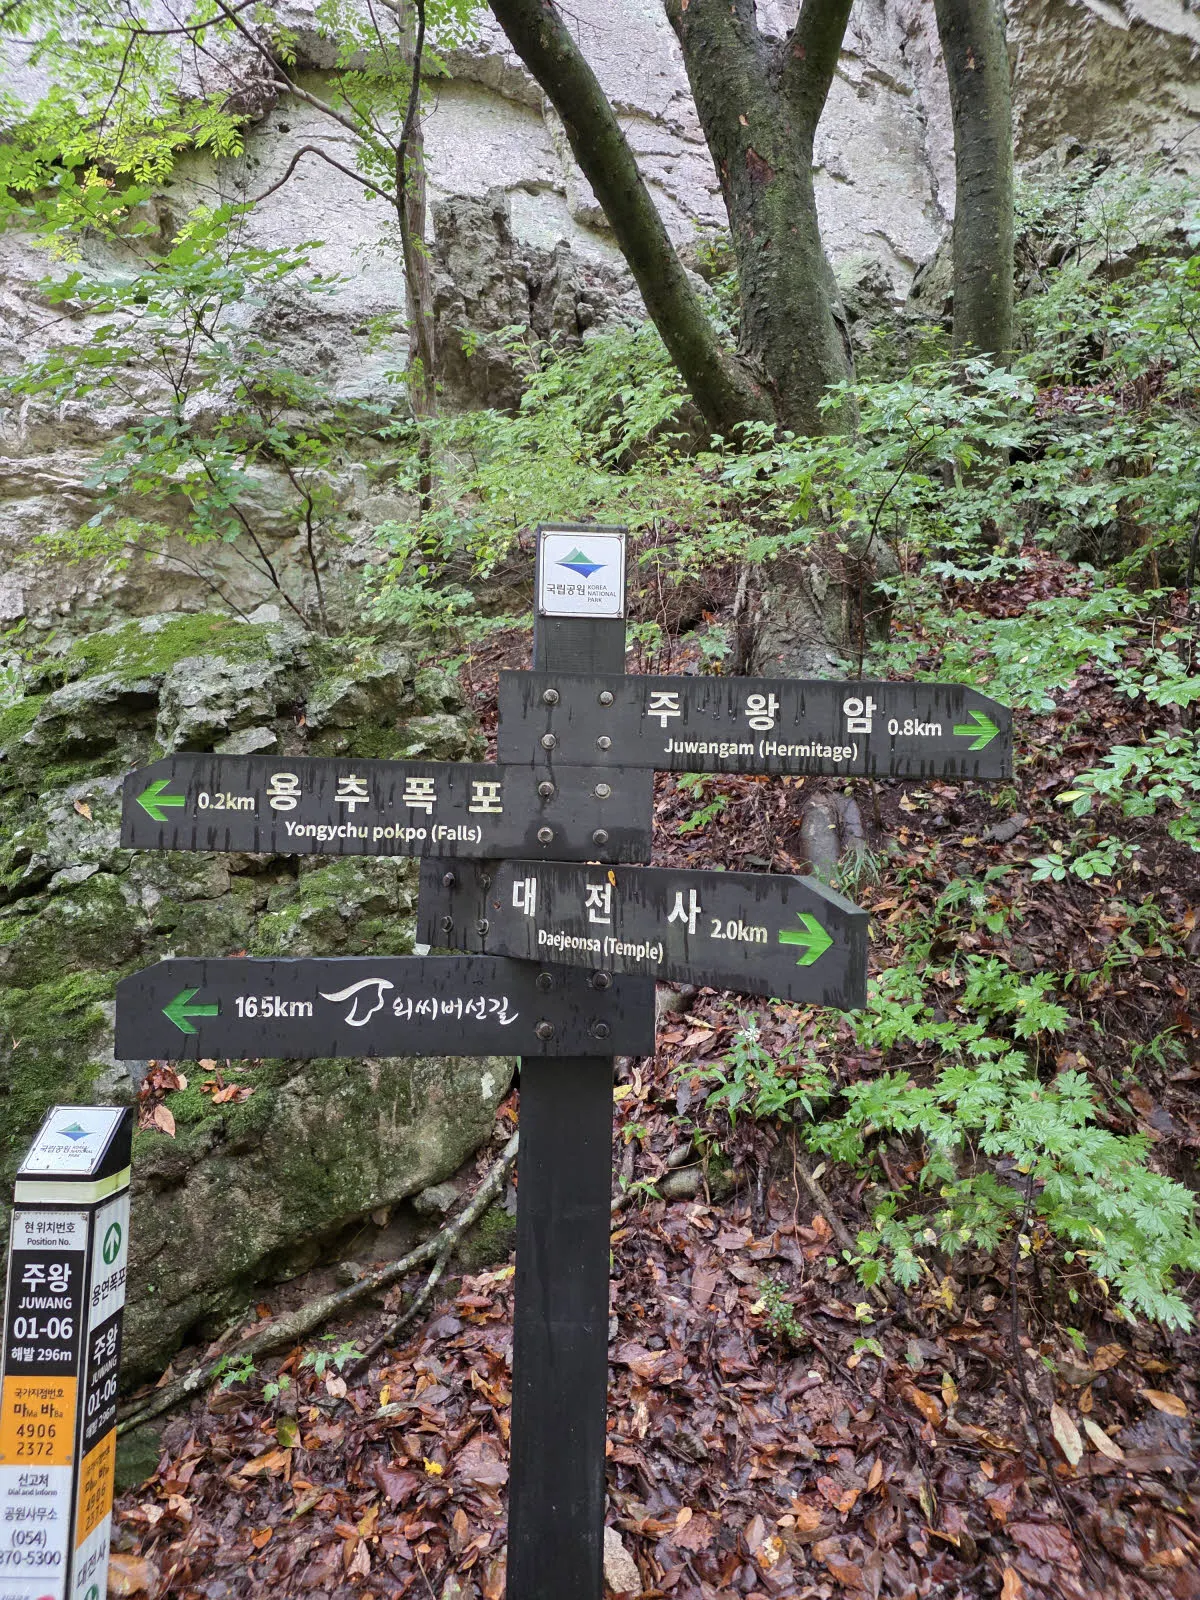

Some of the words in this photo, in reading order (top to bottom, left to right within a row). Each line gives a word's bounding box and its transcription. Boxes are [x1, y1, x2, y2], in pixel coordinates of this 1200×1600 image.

[546, 583, 586, 596] 국립공원
[887, 718, 942, 737] 0.8km
[664, 738, 754, 758] Juwangam
[759, 739, 858, 761] (Hermitage)
[197, 792, 255, 810] 0.2km
[285, 821, 368, 842] Yongychu
[372, 823, 427, 841] pokpo
[431, 825, 483, 843] (Falls)
[710, 918, 768, 944] 2.0km
[538, 929, 601, 952] Daejeonsa
[603, 936, 664, 964] (Temple)
[25, 1222, 34, 1234] 현
[36, 1221, 76, 1234] 위치번호
[27, 1237, 57, 1246] Position
[58, 1238, 71, 1246] No.
[21, 1263, 72, 1293] 주왕
[92, 1267, 126, 1307] 용연폭포
[18, 1296, 73, 1310] JUWANG
[13, 1316, 74, 1340] 01-06
[93, 1323, 118, 1365] 주왕
[11, 1347, 35, 1362] 해발
[37, 1348, 73, 1361] 296m
[14, 1388, 65, 1400] 국가지점번호
[87, 1373, 118, 1417] 01-06
[16, 1424, 56, 1438] 4906
[16, 1442, 54, 1456] 2372
[18, 1473, 49, 1488] 신고처
[7, 1488, 20, 1496] Dial
[21, 1488, 34, 1496] and
[4, 1506, 58, 1521] 공원사무소
[11, 1528, 47, 1549] (054)
